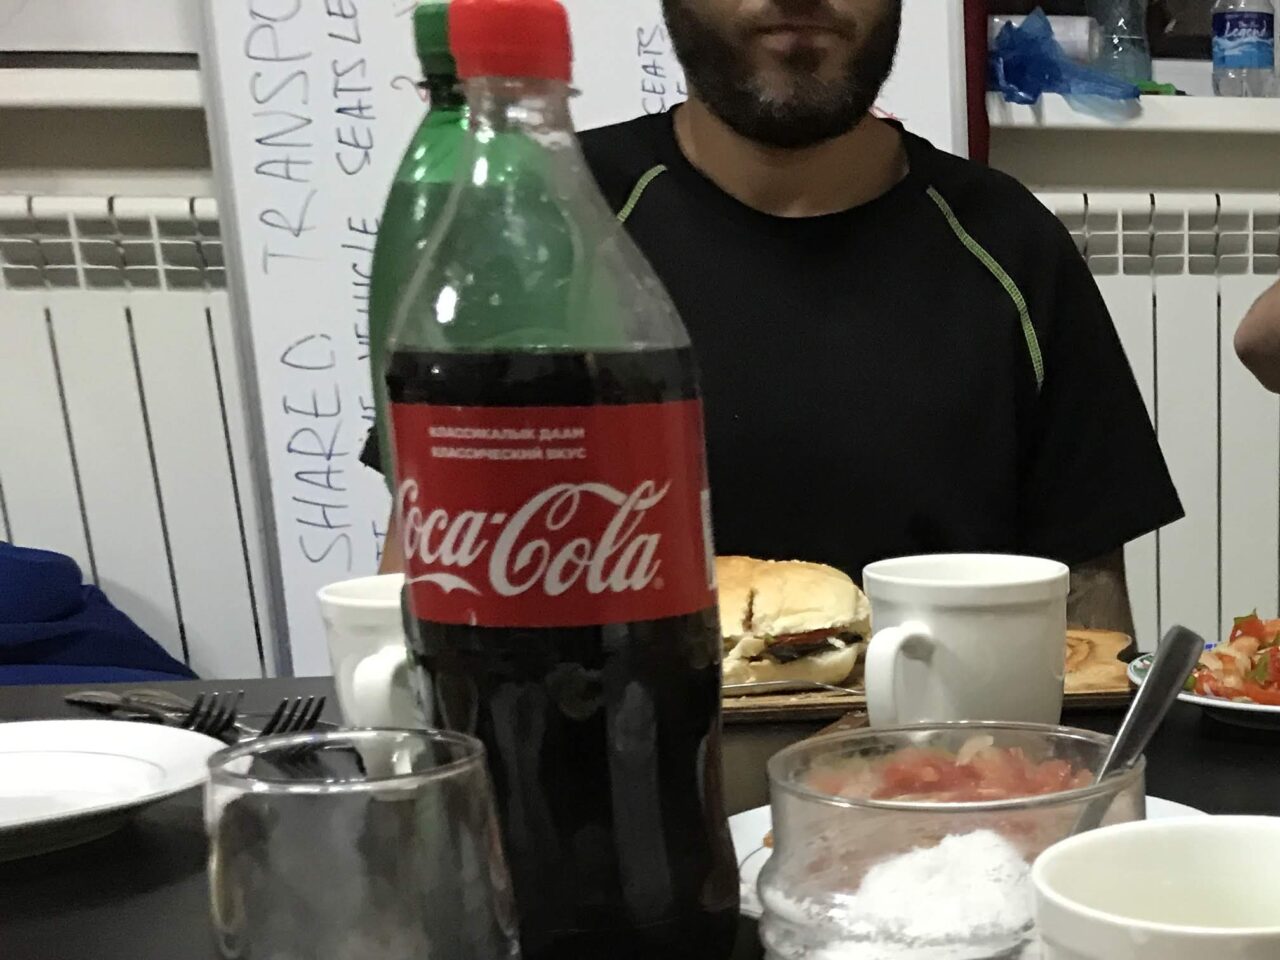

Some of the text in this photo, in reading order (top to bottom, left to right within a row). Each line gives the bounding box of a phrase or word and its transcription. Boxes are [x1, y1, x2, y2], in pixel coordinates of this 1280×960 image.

[331, 57, 377, 176] SEATS
[279, 332, 353, 572] SHARED
[398, 478, 673, 597] Coca-Cola
